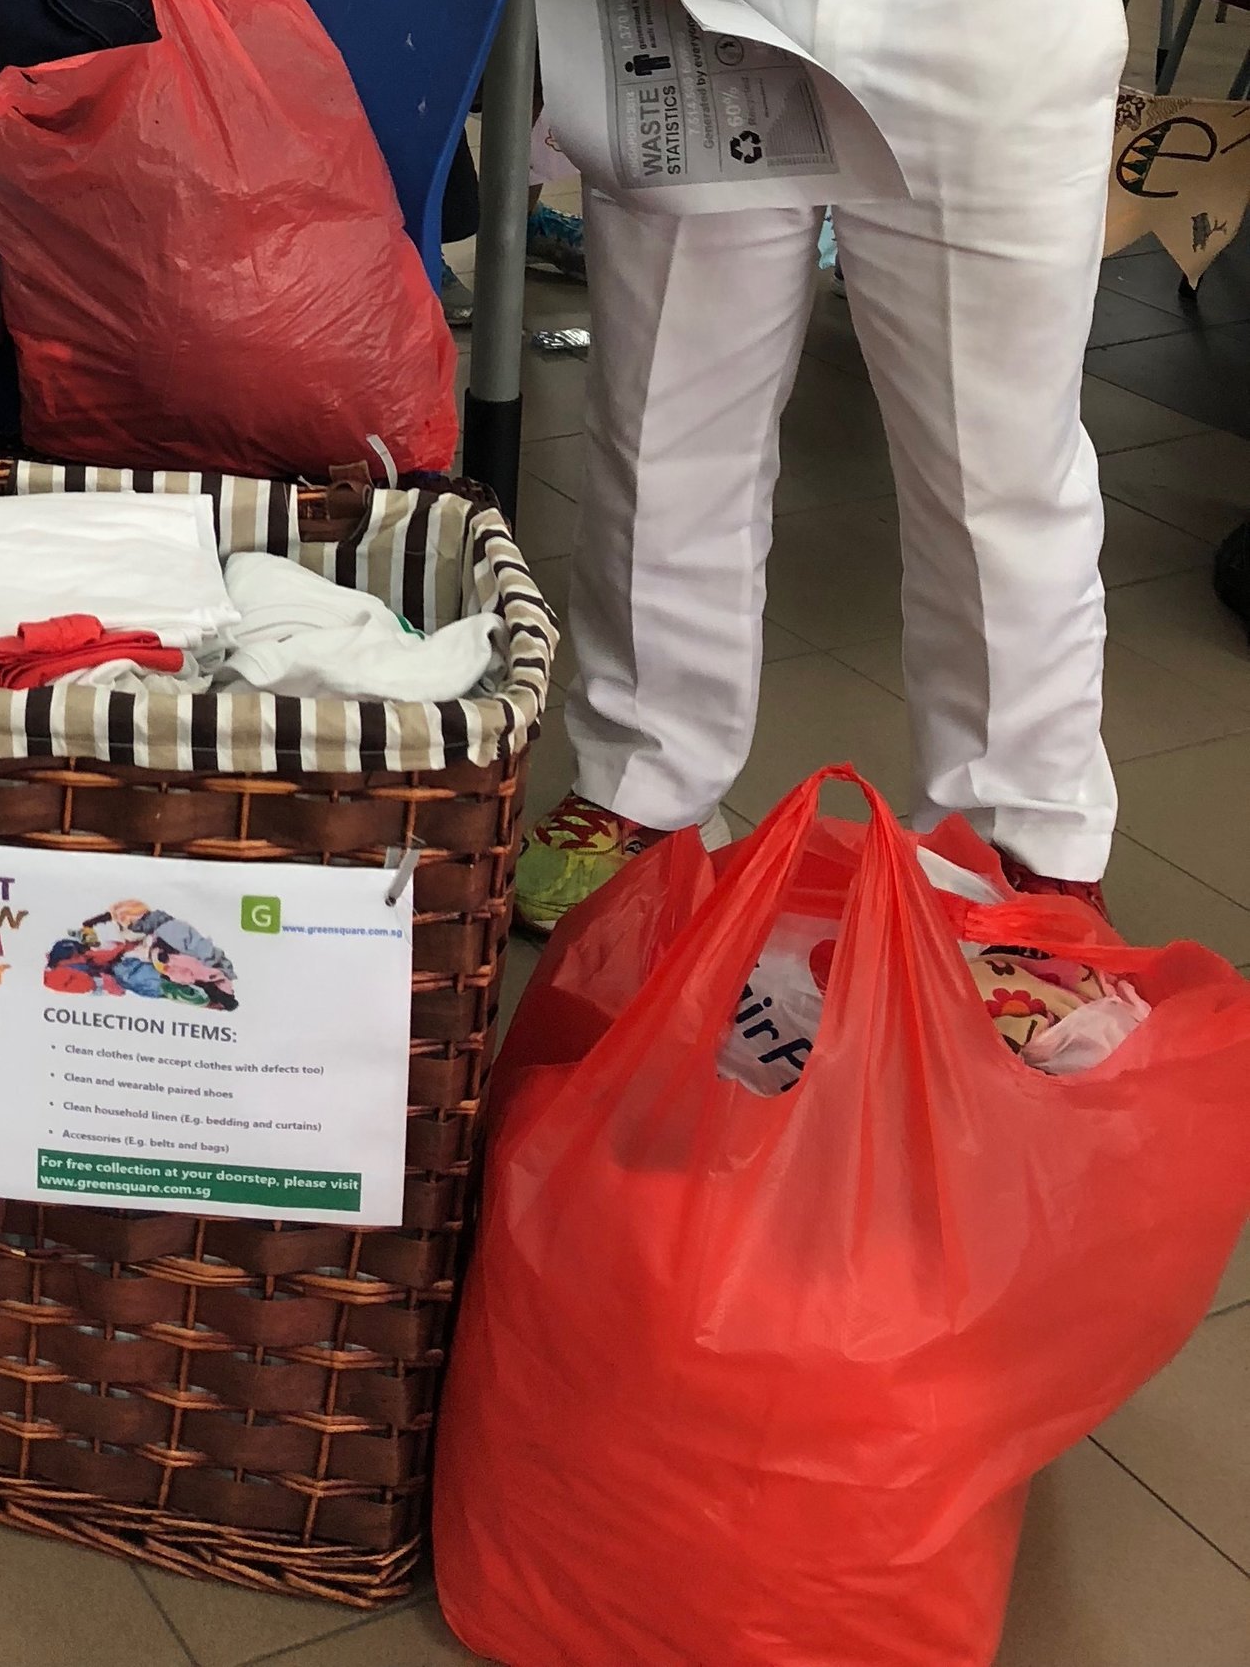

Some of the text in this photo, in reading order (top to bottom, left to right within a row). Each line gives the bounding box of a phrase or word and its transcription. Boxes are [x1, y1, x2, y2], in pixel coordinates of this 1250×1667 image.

[694, 70, 707, 85] by
[697, 89, 715, 150] Generated
[721, 86, 744, 128] 60%
[638, 87, 663, 177] WASTE
[662, 85, 681, 175] STATISTICS
[282, 925, 402, 938] www.greensquare.com.sg
[44, 1008, 237, 1043] COLLECTION ITEMS:
[65, 1045, 324, 1075] Clean clothes (we accept clothes with defects too)
[64, 1072, 233, 1099] Clean and wearable paired shoes
[63, 1102, 322, 1132] Clean household linen (E.g. bedding and curtains)
[62, 1130, 121, 1144] Accessories
[150, 1138, 175, 1149] belts
[178, 1140, 197, 1150] and
[200, 1142, 229, 1153] bags)
[40, 1174, 211, 1198] www.greensquare.com.sg
[41, 1155, 359, 1191] For free collection at your doorstep, please visit
